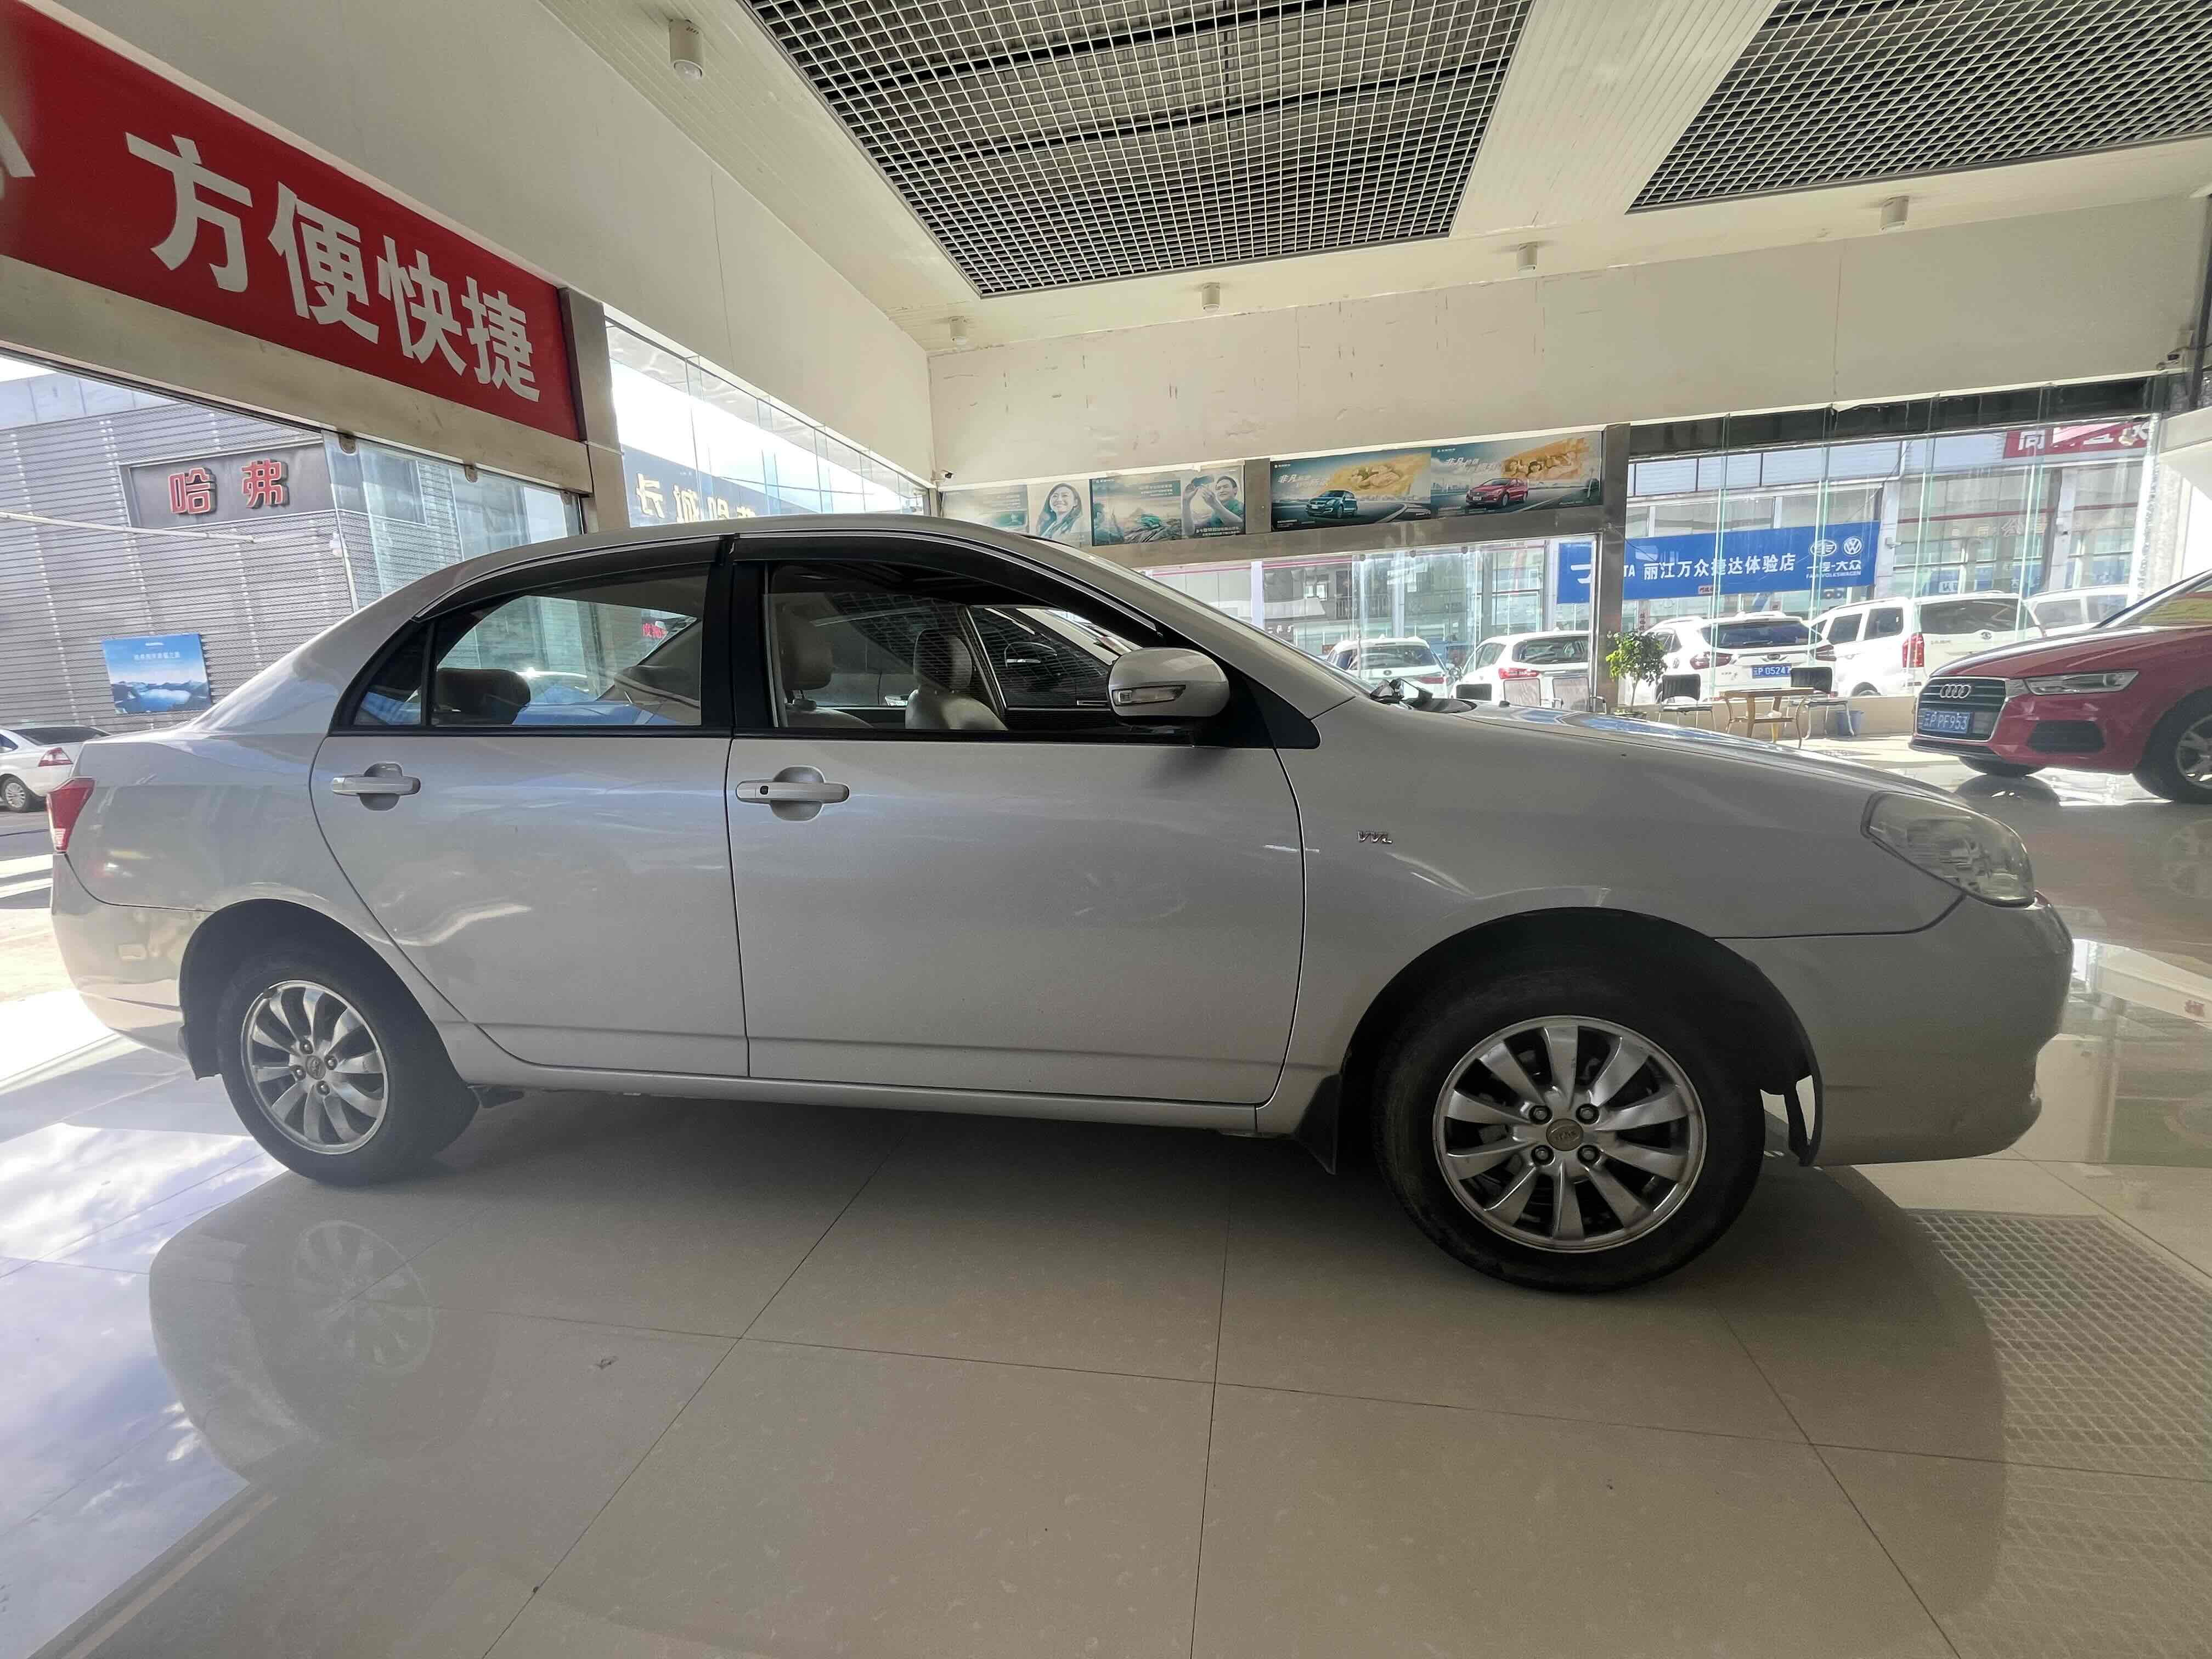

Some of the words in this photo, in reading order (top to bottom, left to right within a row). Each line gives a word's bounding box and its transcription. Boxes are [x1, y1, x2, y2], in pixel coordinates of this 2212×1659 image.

[125, 132, 540, 403] 方便快捷
[168, 459, 284, 514] 哈弗
[1644, 553, 1796, 580] 丽江万众捷达体验店
